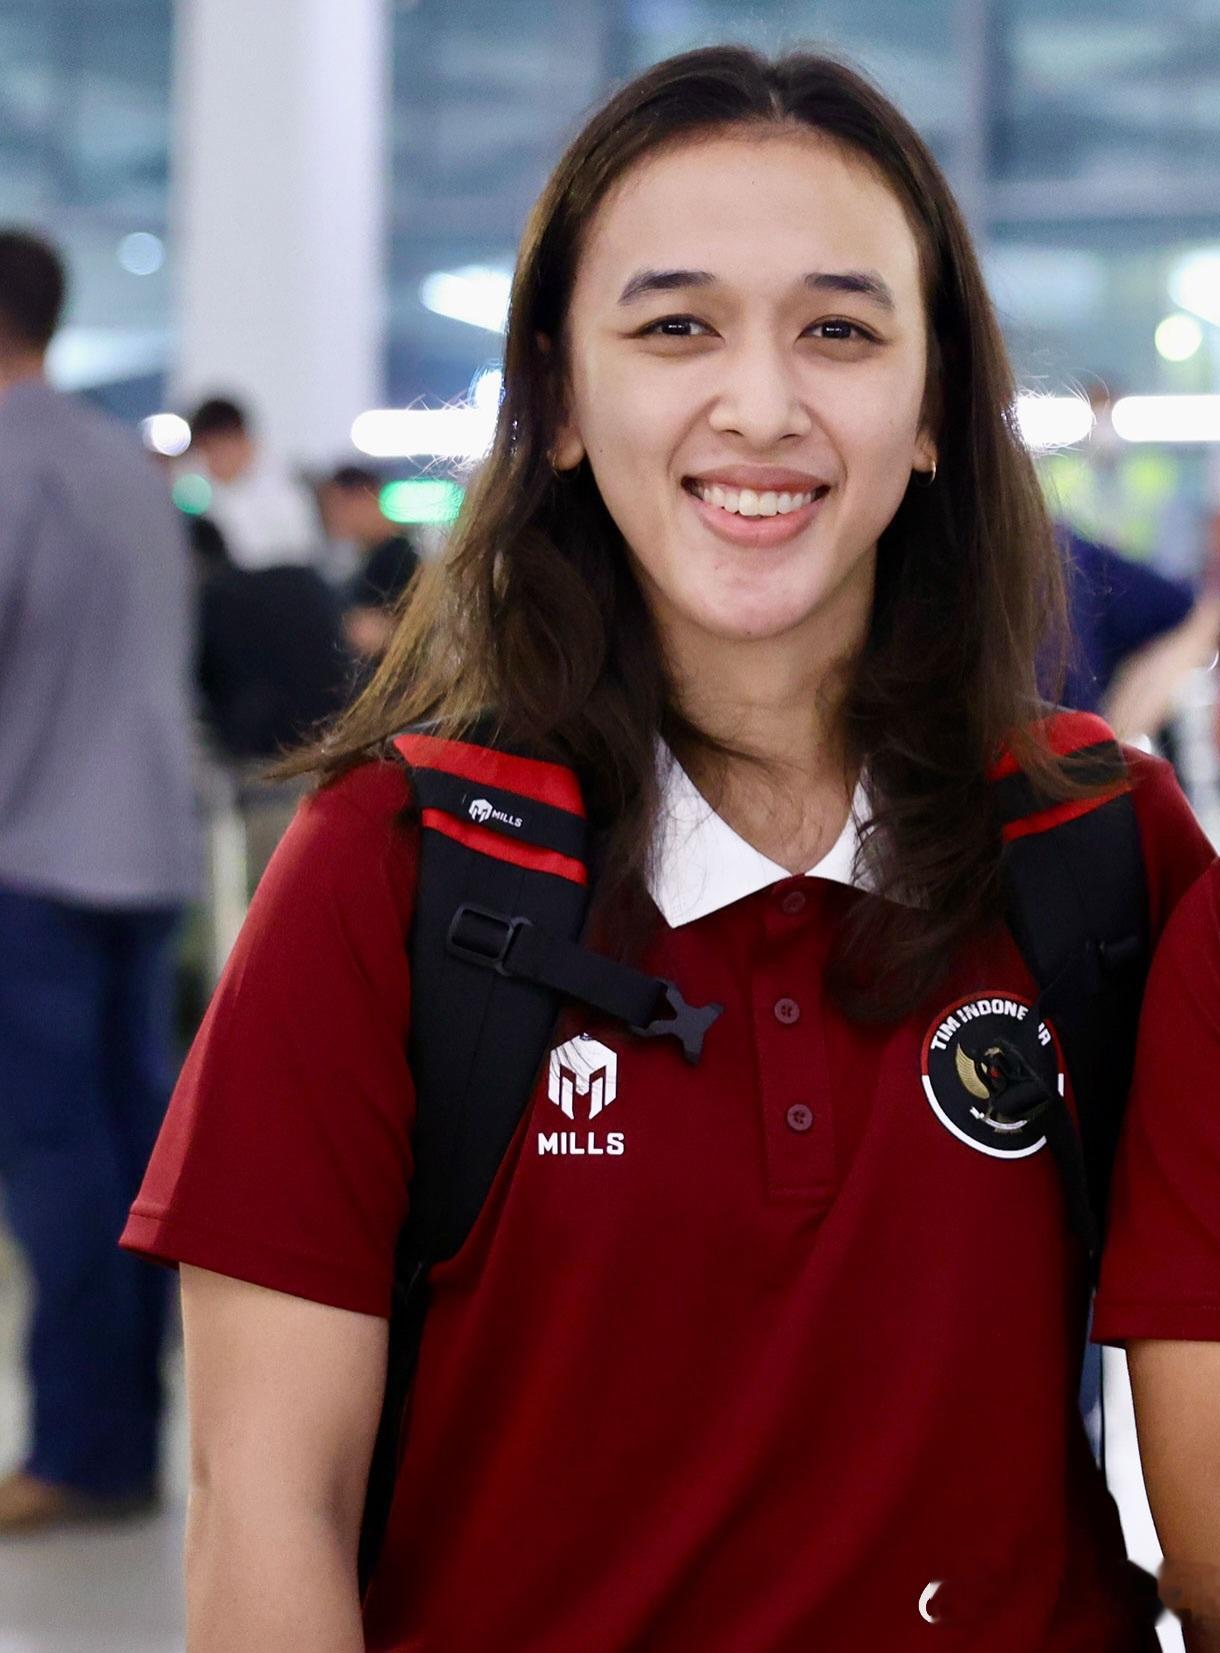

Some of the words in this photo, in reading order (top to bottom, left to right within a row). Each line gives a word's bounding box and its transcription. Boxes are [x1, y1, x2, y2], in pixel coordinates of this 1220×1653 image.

[491, 809, 523, 828] MILLS
[931, 1016, 961, 1050] TIM
[538, 1132, 625, 1155] MILLS
